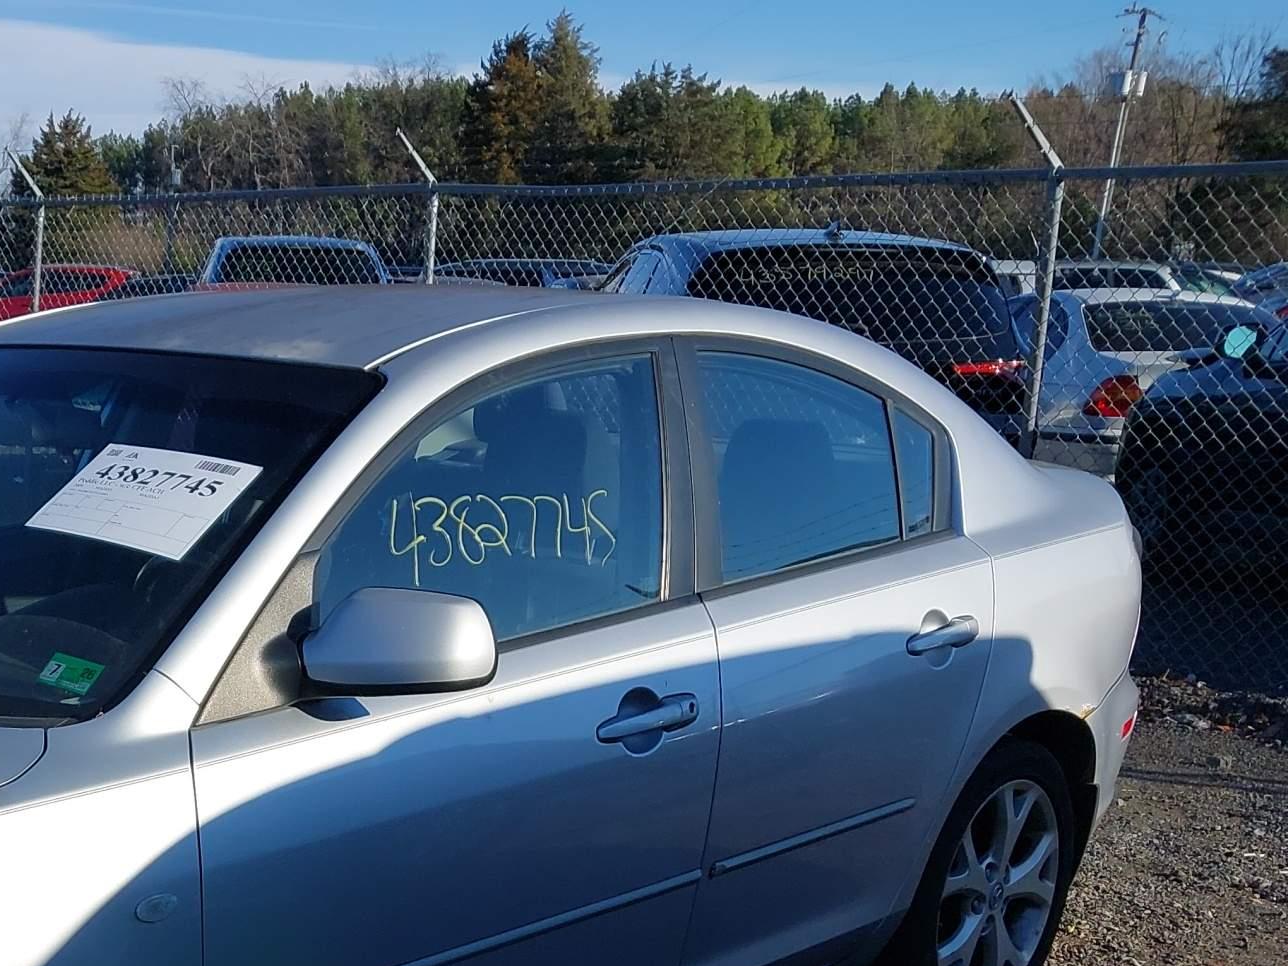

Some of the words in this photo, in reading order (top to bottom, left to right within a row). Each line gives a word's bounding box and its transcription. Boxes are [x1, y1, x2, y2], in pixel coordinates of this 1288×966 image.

[95, 463, 225, 497] 43827745
[390, 489, 617, 588] 43827745
[49, 663, 62, 676] 7
